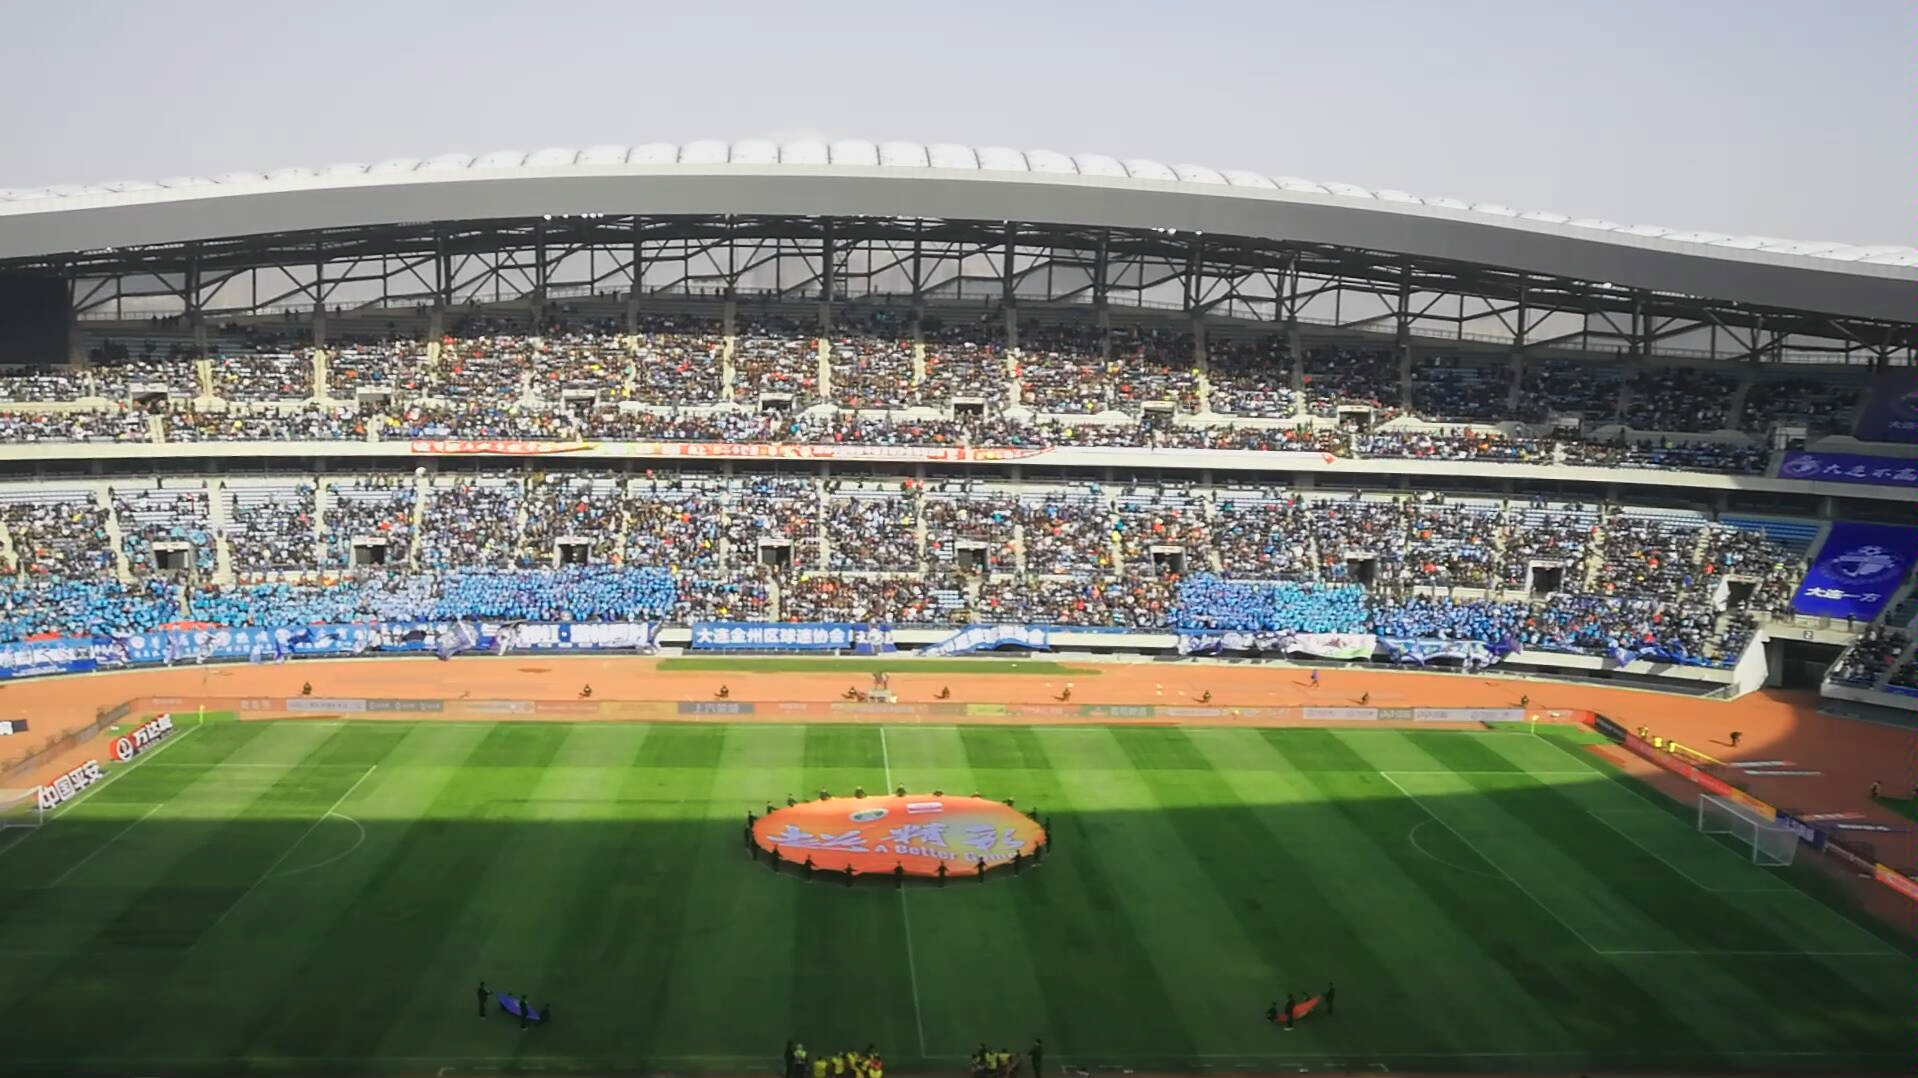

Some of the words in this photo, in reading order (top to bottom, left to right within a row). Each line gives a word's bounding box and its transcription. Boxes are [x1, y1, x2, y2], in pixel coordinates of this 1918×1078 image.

[1804, 587, 1881, 602] 大连一方
[697, 628, 845, 644] 大连金州区球迷协会
[41, 760, 103, 809] 中国平安
[875, 844, 888, 853] A
[895, 844, 956, 860] Better
